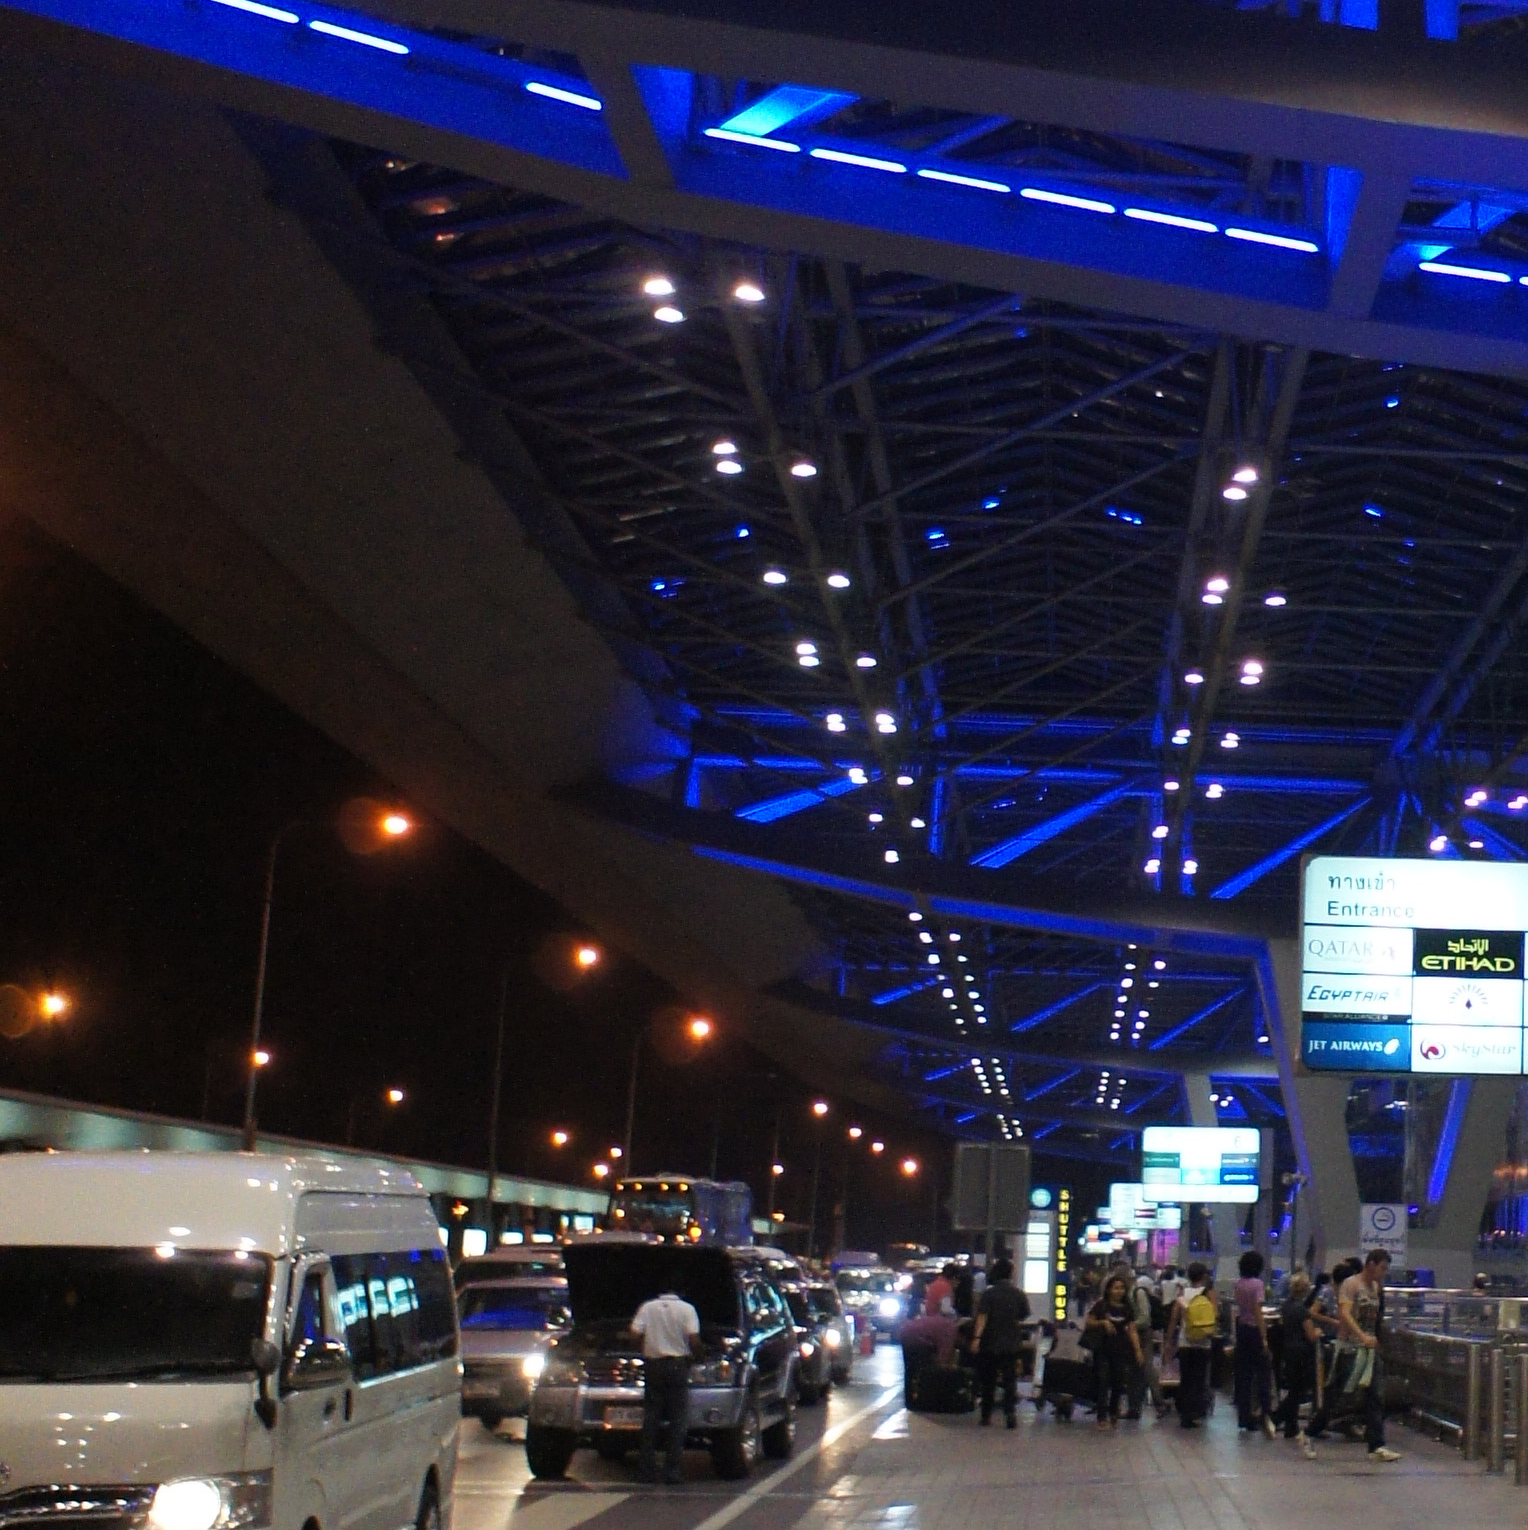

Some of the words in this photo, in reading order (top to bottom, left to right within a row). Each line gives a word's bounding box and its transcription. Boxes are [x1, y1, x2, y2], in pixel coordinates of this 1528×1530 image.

[1328, 871, 1396, 891] ทางเข้า
[1327, 900, 1415, 919] Entrance
[1307, 938, 1374, 958] QATAR
[1420, 955, 1516, 973] ETIHAD
[1307, 1040, 1328, 1054] JET
[1329, 1040, 1384, 1053] AIRWAYS
[1056, 1188, 1071, 1273] SHUTTLE
[1054, 1284, 1068, 1321] BUS
